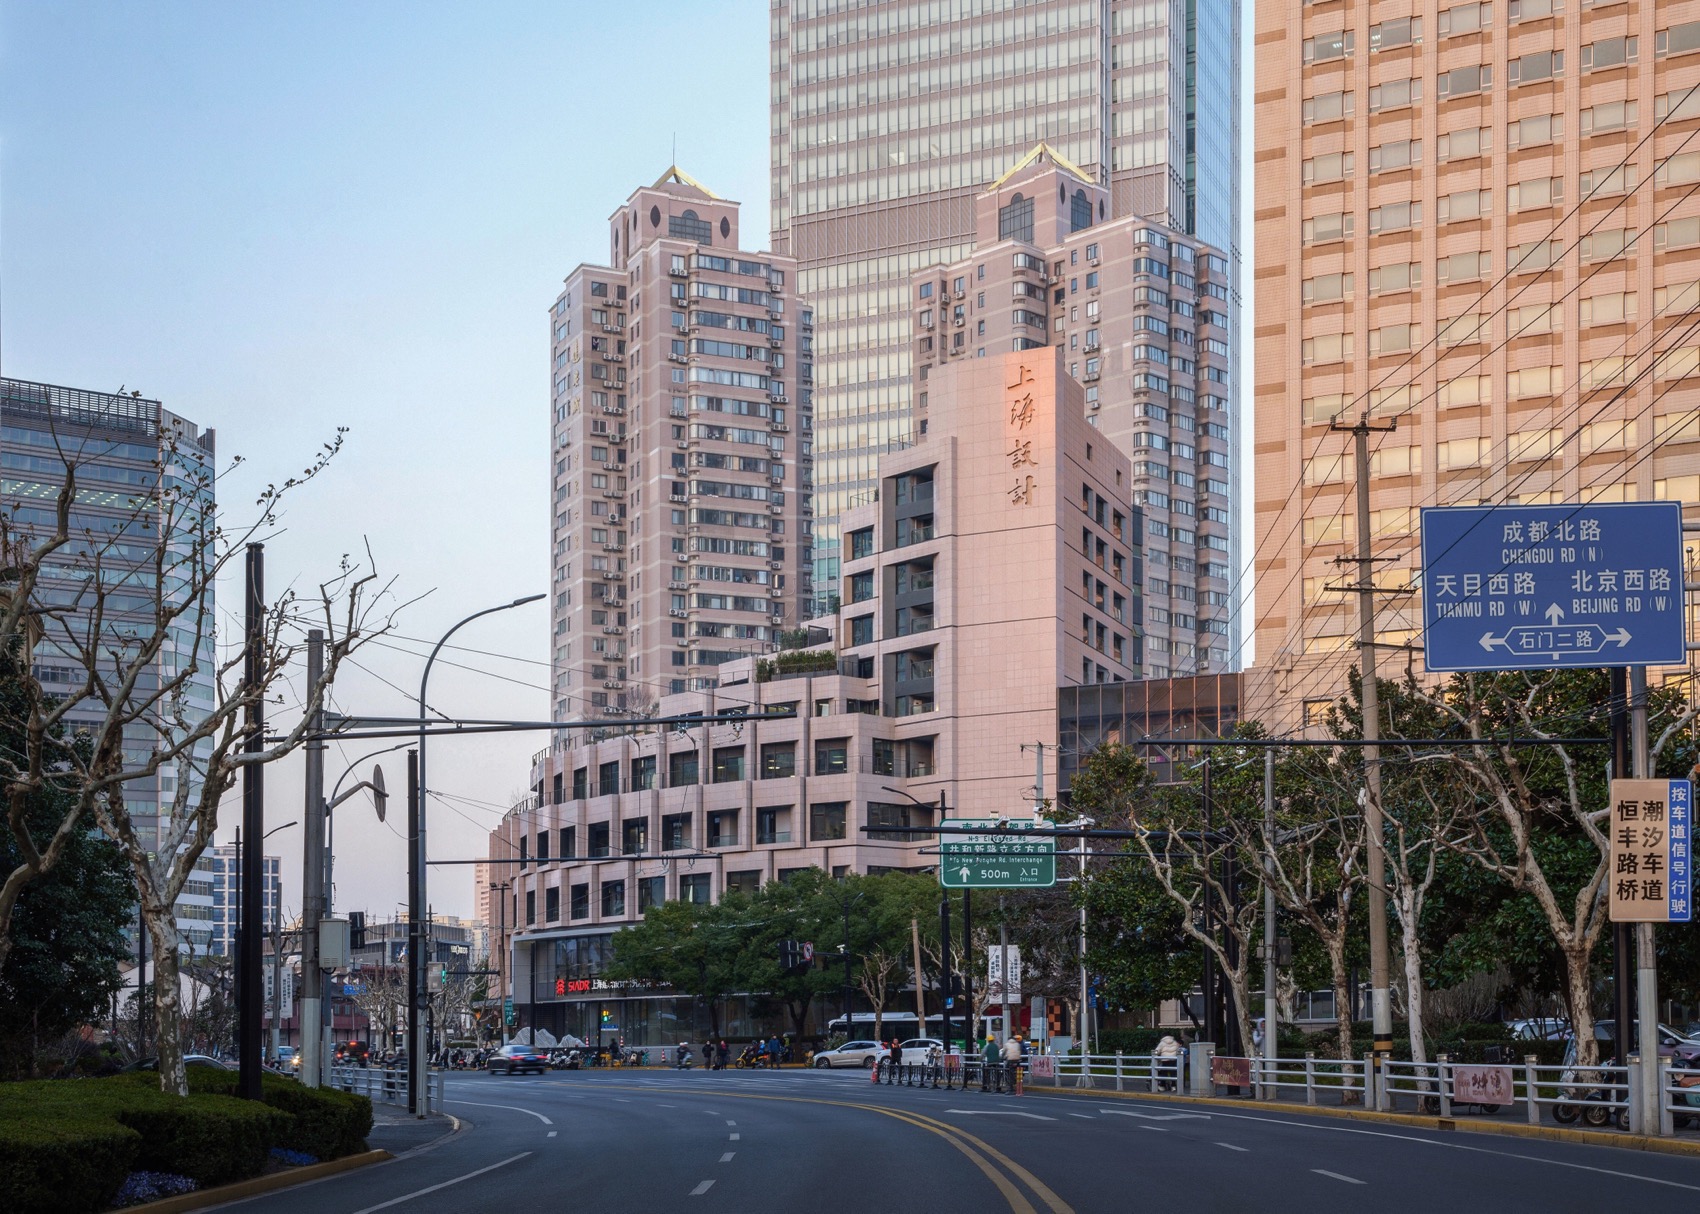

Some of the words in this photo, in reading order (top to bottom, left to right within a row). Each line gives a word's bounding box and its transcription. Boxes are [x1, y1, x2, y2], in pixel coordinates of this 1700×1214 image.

[1502, 518, 1601, 543] 成都北路
[1502, 548, 1554, 564] CHENGDU
[1560, 547, 1576, 562] RD
[1435, 571, 1536, 597] 天目西路
[1571, 567, 1672, 592] 北京西路
[1436, 602, 1482, 618] TIANMU
[1489, 601, 1505, 617] RD
[1572, 598, 1619, 614] BEIJING
[1625, 597, 1642, 613] RD
[1518, 630, 1593, 649] 石门二路
[1616, 800, 1639, 901] 恒丰路桥
[1641, 800, 1664, 901] 潮汐车道
[1671, 787, 1686, 913] 按车道信号行驶
[1009, 857, 1043, 865] Interchange
[980, 869, 1010, 879] 500m
[1020, 867, 1038, 876] 入口
